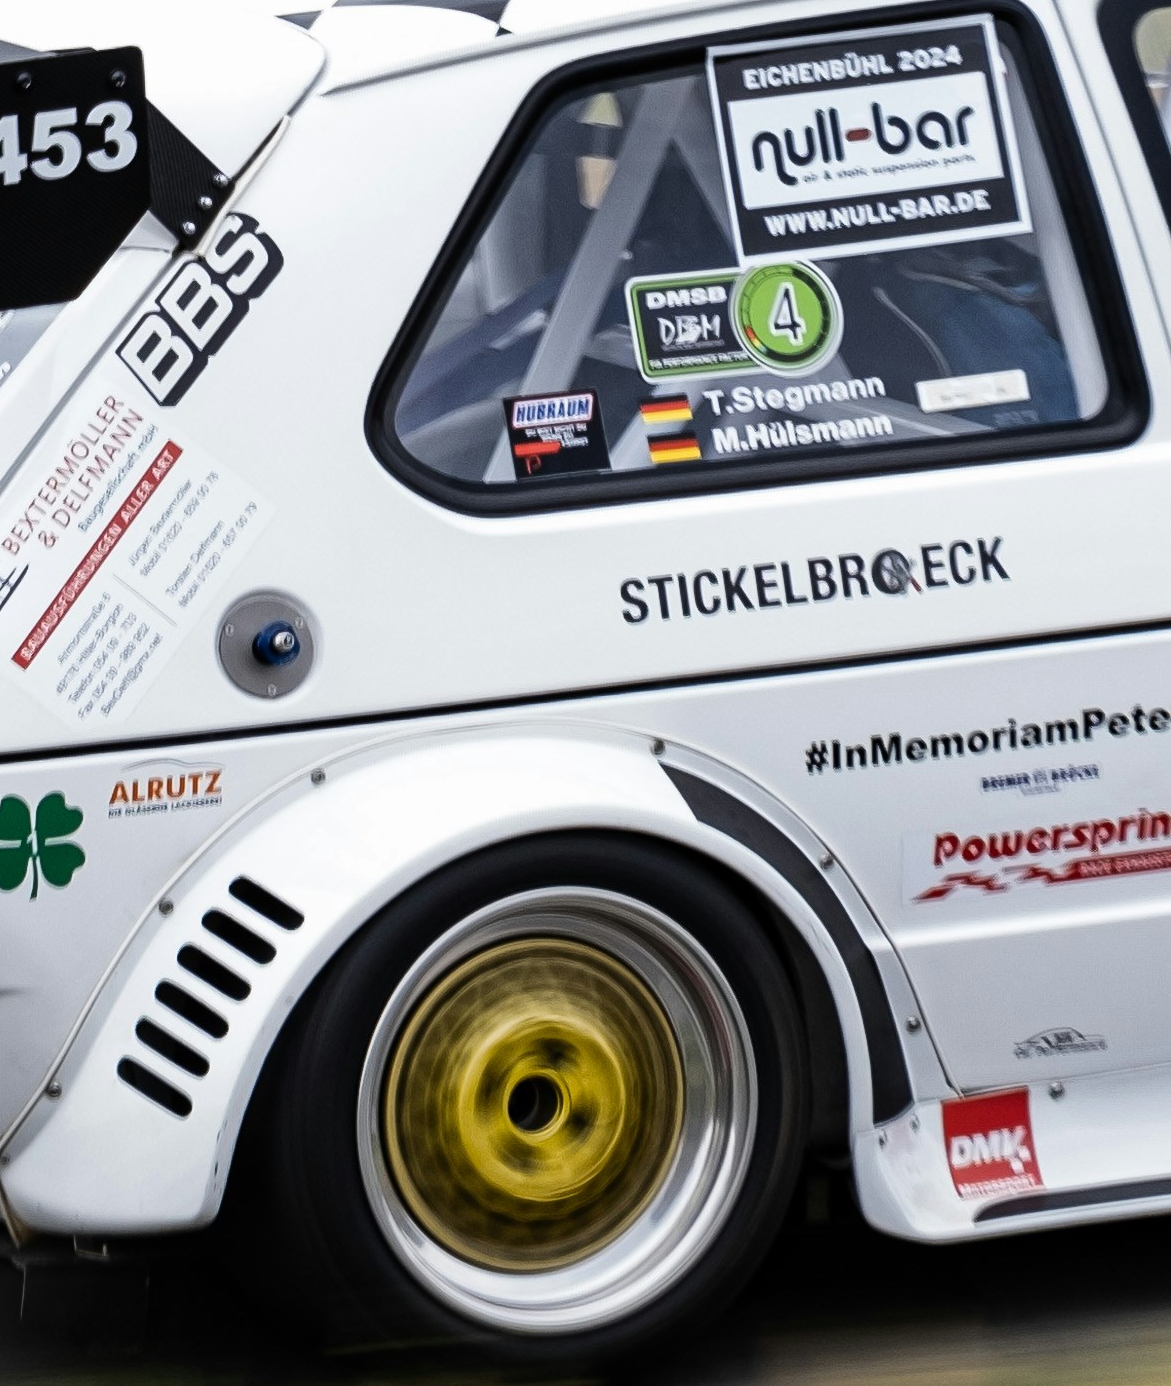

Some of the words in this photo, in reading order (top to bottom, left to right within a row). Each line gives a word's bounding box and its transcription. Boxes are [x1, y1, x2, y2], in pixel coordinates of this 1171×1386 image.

[742, 51, 894, 90] EICHENBÜHL
[897, 45, 963, 72] 2024
[752, 101, 974, 186] null-bar
[763, 189, 991, 237] WWW.NULL-BAR.DE
[115, 211, 284, 407] BBS
[645, 285, 727, 310] DMSB
[768, 281, 807, 346] 4
[516, 398, 589, 422] HUBRAUM
[702, 377, 886, 416] T.Stegmann
[711, 415, 894, 454] M.Hülsmann
[0, 392, 125, 556] BEXTERMÖLLER
[35, 525, 58, 549] &
[50, 407, 143, 529] DELFMANN
[119, 479, 153, 523] ALLER
[150, 448, 175, 479] ART
[805, 703, 1171, 775] #InMemoriamPete
[109, 769, 222, 805] ALRUTZ
[932, 807, 1171, 868] Powersprin
